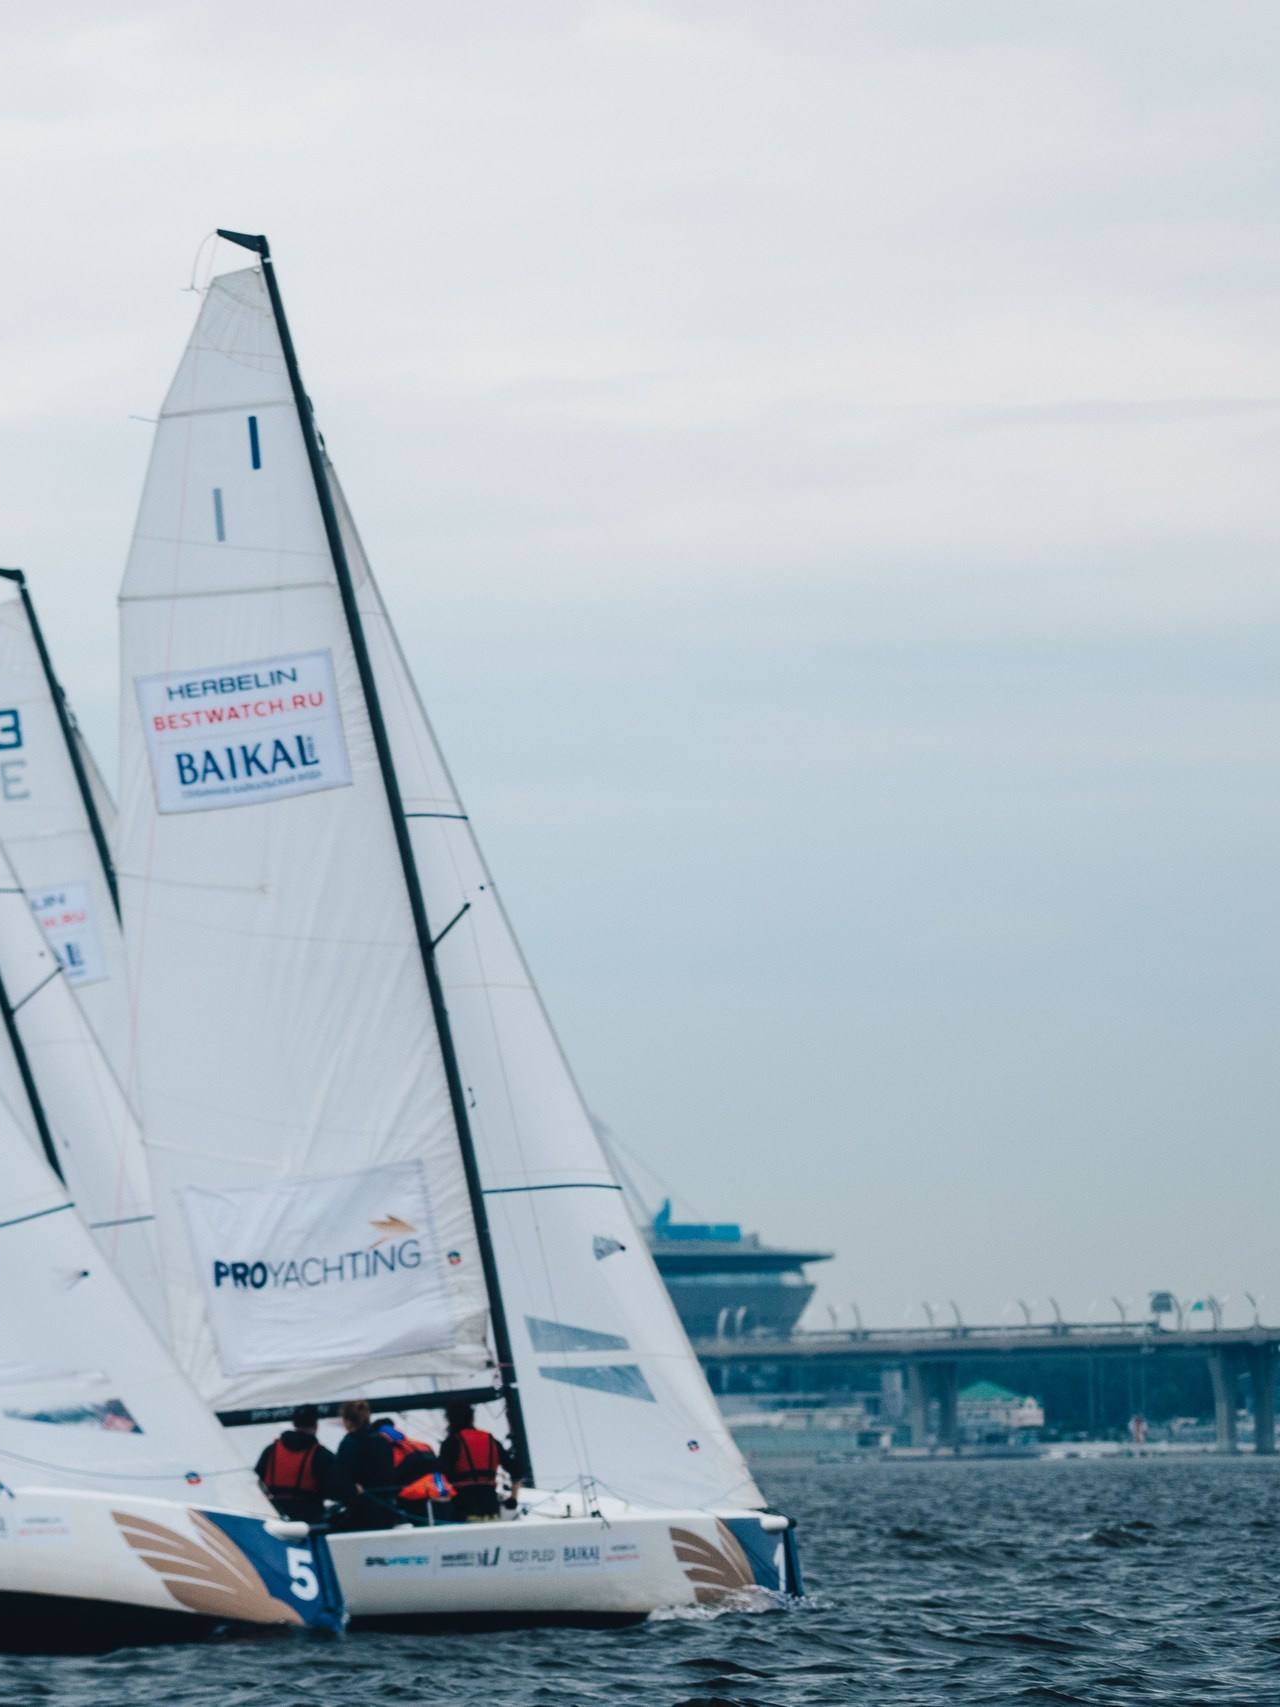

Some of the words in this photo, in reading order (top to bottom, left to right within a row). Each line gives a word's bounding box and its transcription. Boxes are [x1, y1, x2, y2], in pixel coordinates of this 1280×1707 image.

[248, 416, 261, 470] 1
[166, 667, 298, 701] HERBELIN
[153, 691, 324, 733] BESTWATCH.RU
[174, 734, 320, 787] BAIKAL
[213, 1239, 422, 1290] PROYACHTING
[286, 1547, 320, 1602] 5
[772, 1542, 787, 1592] 1
